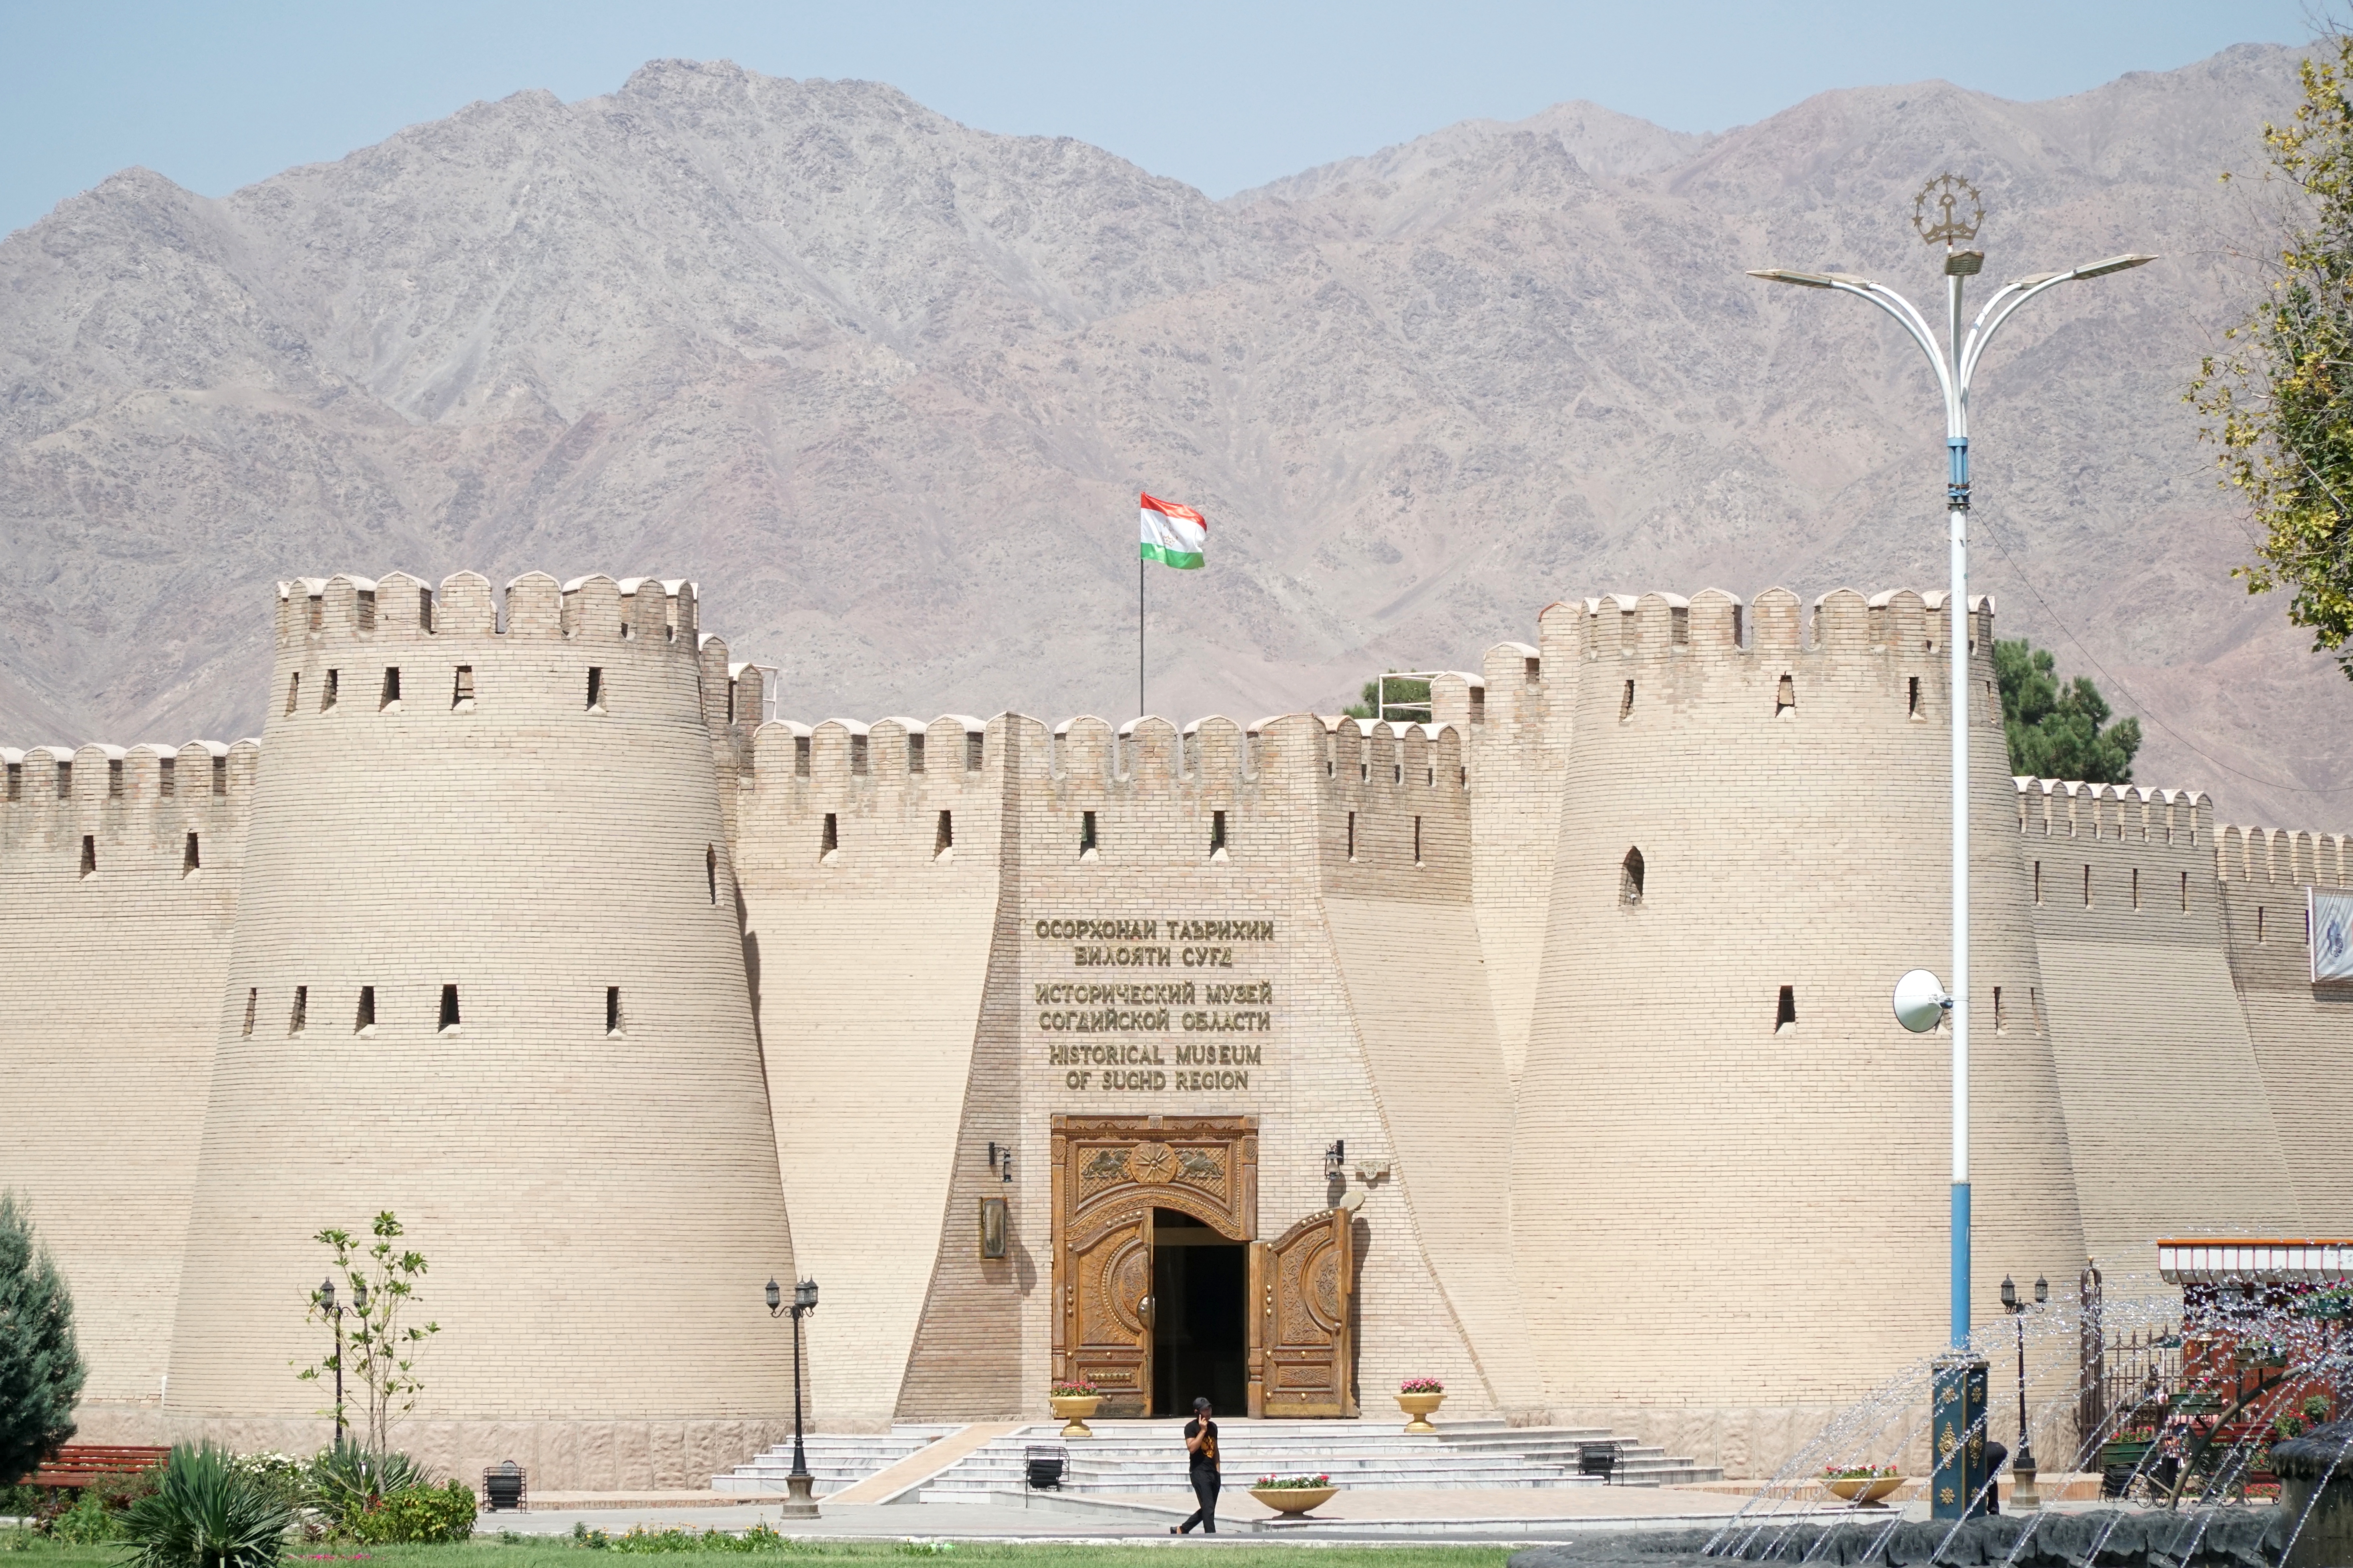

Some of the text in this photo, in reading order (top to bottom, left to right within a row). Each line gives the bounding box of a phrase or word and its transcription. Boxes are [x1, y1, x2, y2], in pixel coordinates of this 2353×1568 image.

[1036, 920, 1273, 939] ОСОРХОНАИ ТАЪРИХИИ
[1075, 946, 1170, 965] ВИЛОЯТИ
[1035, 980, 1272, 1004] ИСТОРИЧЕСКИЙ МУЗЕЙ
[1039, 1007, 1270, 1030] СОГДИЙСКОЙ ОБЛАСТИ
[1049, 1045, 1261, 1065] HISTORICAL MUSEUM
[1066, 1070, 1091, 1089] OF
[1175, 1071, 1248, 1090] REGION
